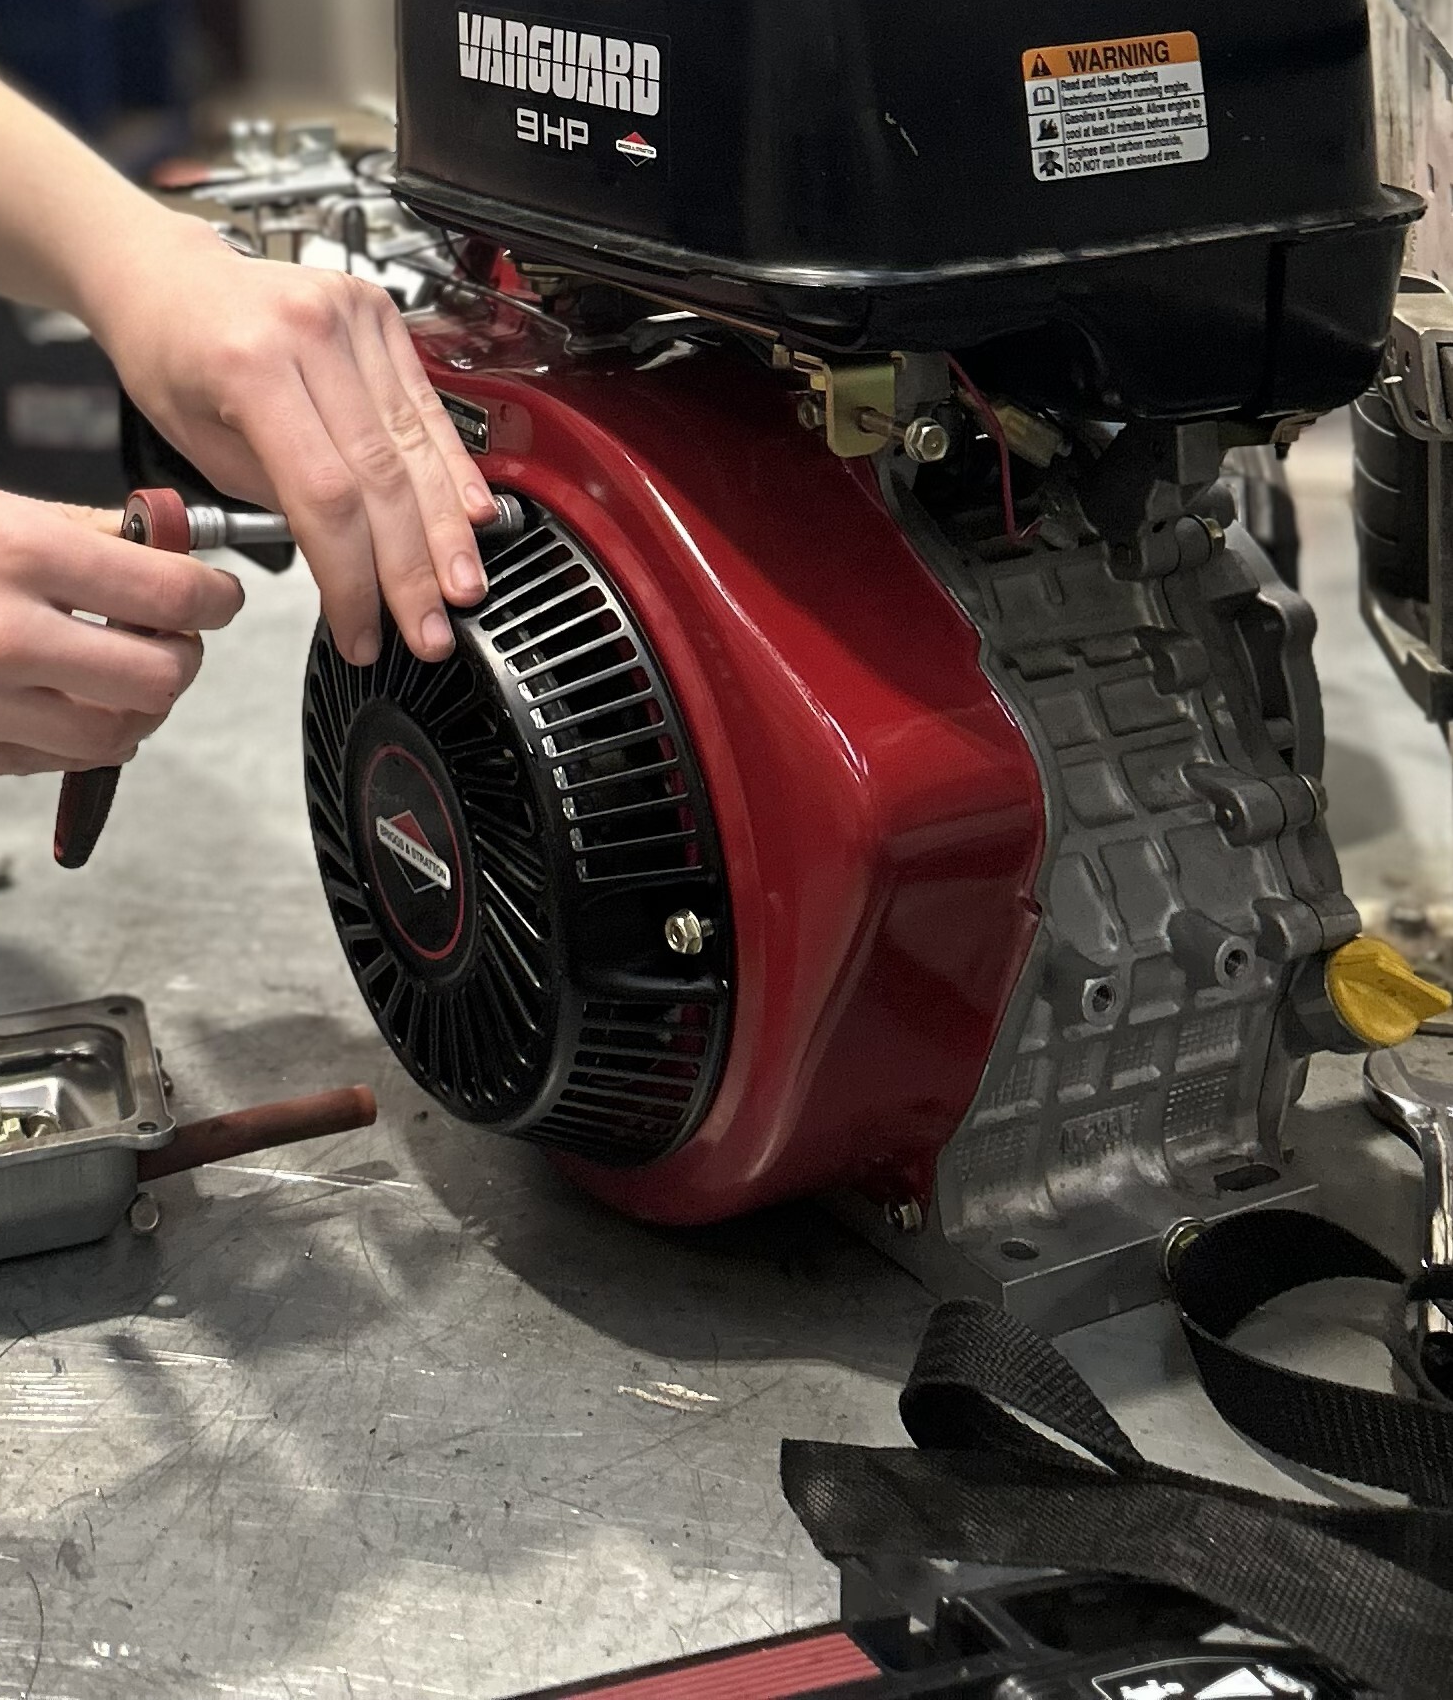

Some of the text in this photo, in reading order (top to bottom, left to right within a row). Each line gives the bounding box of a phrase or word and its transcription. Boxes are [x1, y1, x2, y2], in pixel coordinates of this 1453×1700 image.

[457, 11, 661, 117] VANGUARD
[1067, 40, 1170, 73] WARNING
[1082, 76, 1096, 88] and
[1121, 70, 1158, 85] Operating
[1108, 88, 1132, 101] before
[1133, 84, 1163, 99] running
[1065, 111, 1097, 125] Gasoline
[1147, 102, 1166, 114] Allow
[1167, 99, 1191, 117] engine
[1192, 98, 1200, 109] to
[1083, 125, 1090, 137] at
[1092, 123, 1110, 137] least
[1117, 120, 1146, 133] minutes
[1146, 117, 1170, 129] before
[1067, 146, 1098, 161] Engines
[1099, 142, 1116, 155] emit
[1117, 140, 1144, 152] carbon
[1068, 161, 1082, 174] DO
[1083, 159, 1101, 172] NOT
[1103, 158, 1116, 169] run
